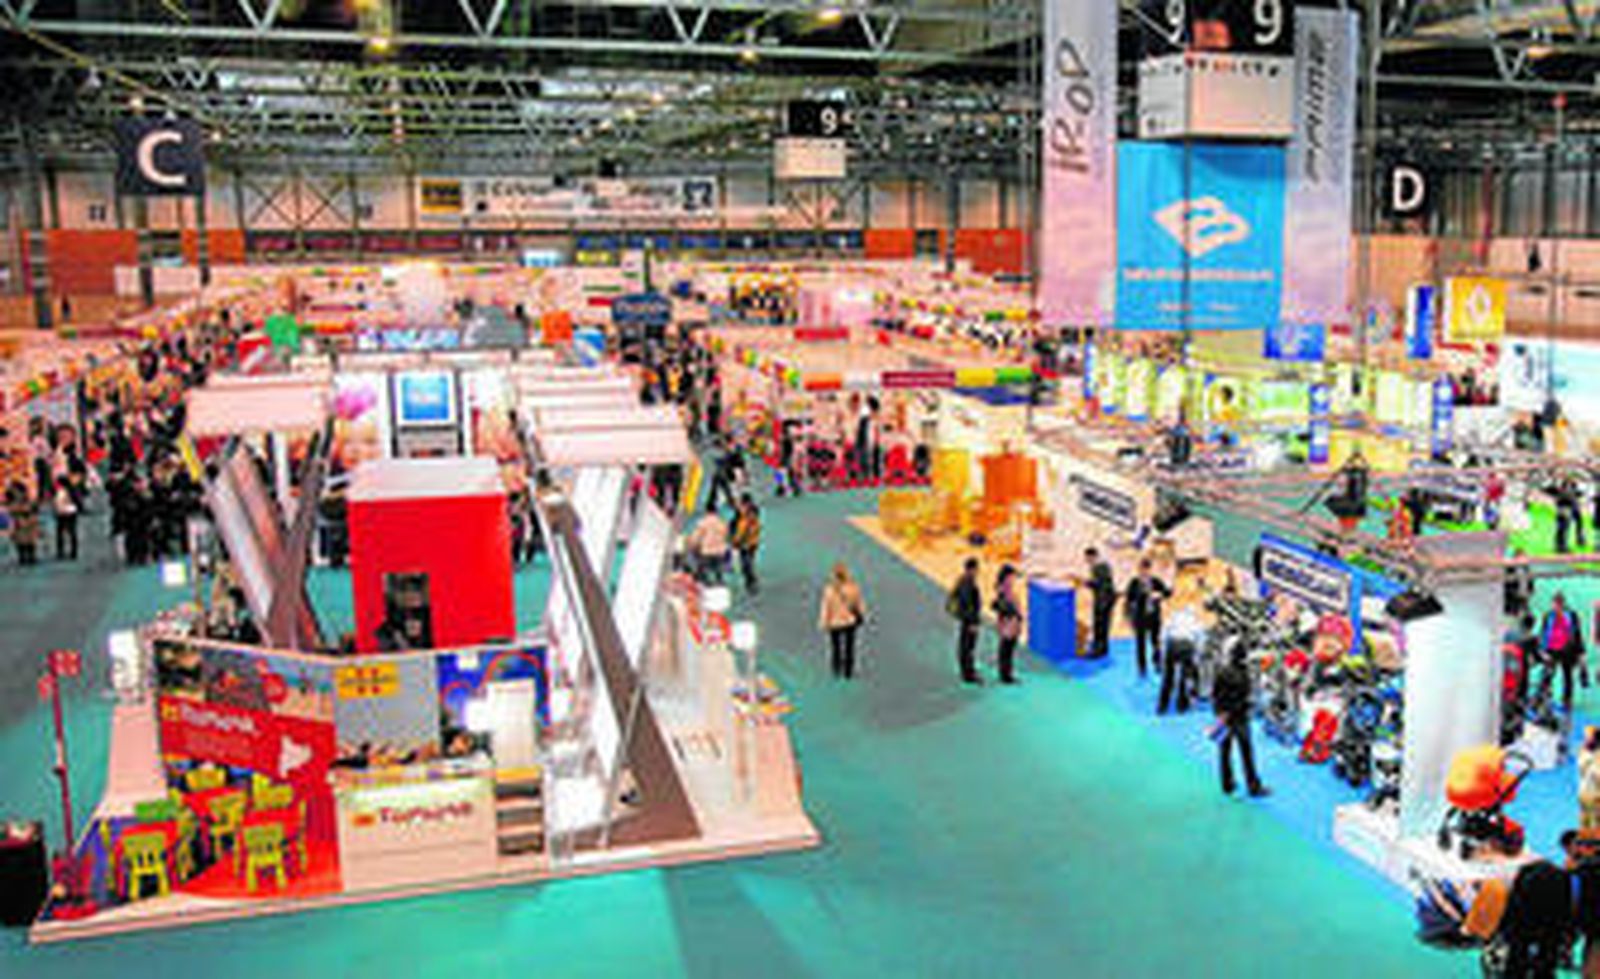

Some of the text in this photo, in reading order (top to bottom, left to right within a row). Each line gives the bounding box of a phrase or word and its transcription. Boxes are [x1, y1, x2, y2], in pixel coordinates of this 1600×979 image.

[1254, 0, 1282, 45] 9
[820, 106, 838, 135] 9
[137, 129, 186, 186] C
[1393, 165, 1424, 210] D
